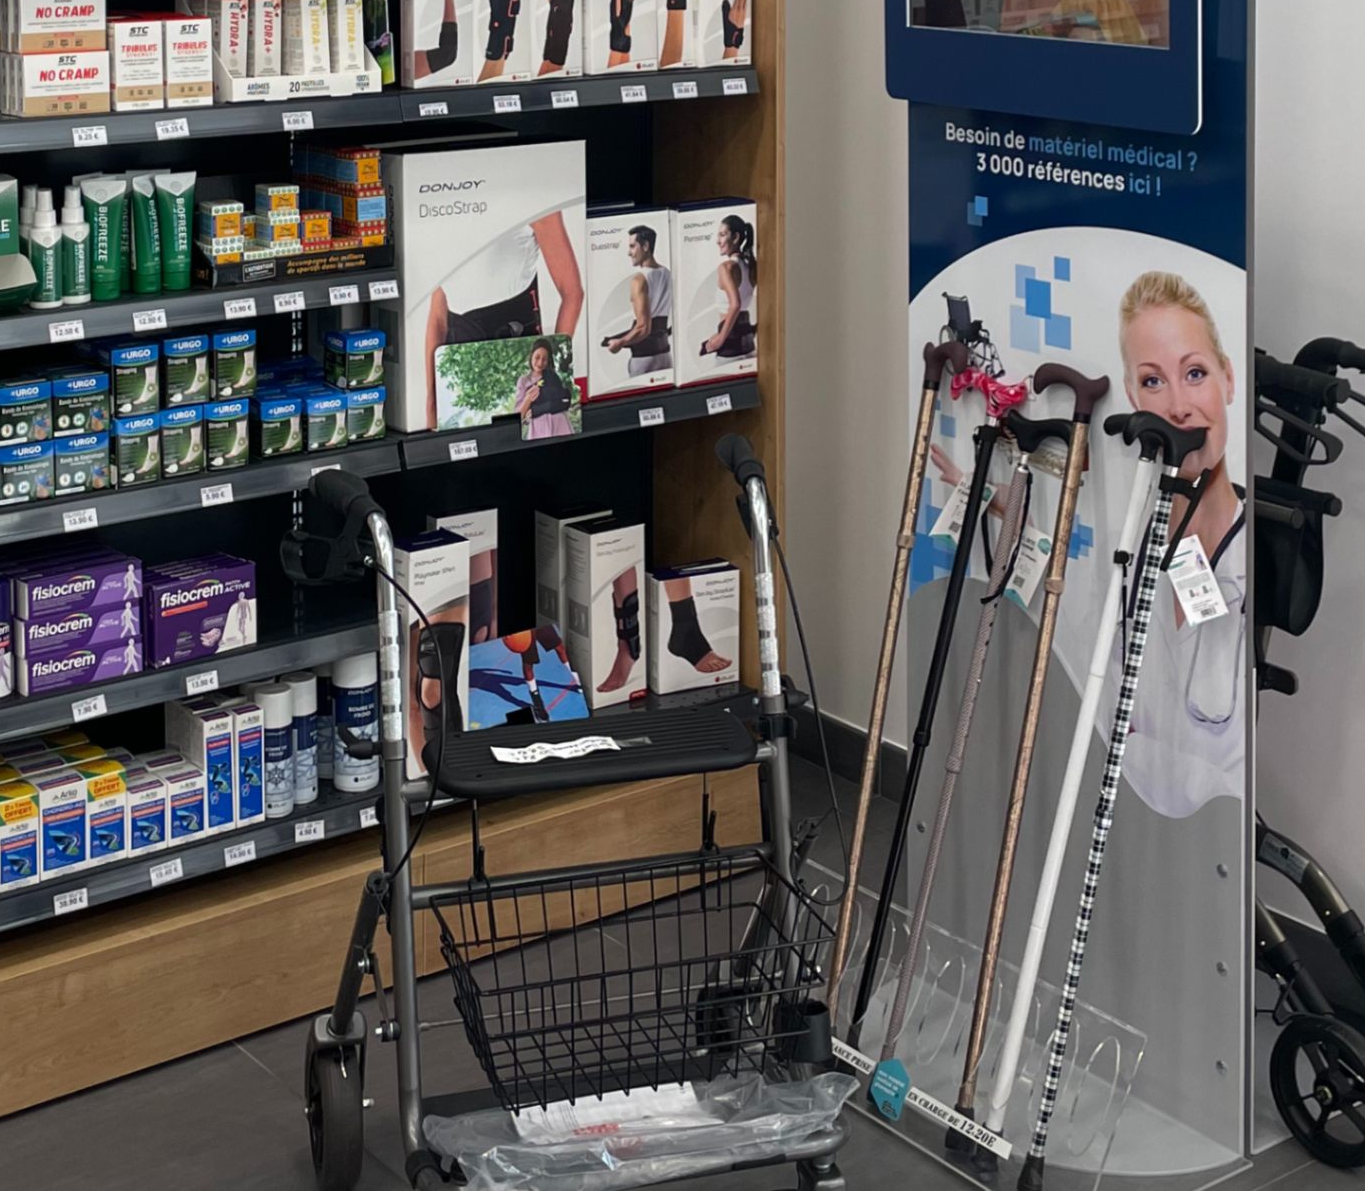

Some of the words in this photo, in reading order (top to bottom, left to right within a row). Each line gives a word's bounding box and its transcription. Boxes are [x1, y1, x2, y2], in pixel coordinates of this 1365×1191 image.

[36, 6, 52, 18] NO
[55, 5, 94, 18] CRAMP
[290, 82, 300, 92] 20
[945, 122, 1001, 150] Besoin
[1004, 128, 1025, 151] de
[1029, 132, 1103, 161] matériel
[1107, 140, 1182, 170] médical
[1187, 151, 1198, 171] ?
[1027, 159, 1125, 192] références
[1129, 173, 1151, 195] ici
[1155, 177, 1161, 195] !
[419, 180, 483, 193] DONJOY
[419, 201, 487, 219] DiscoStrap
[178, 340, 201, 349] URGO
[228, 334, 249, 343] URGO
[126, 349, 150, 358] URGO
[33, 579, 95, 601] fisiocrem
[29, 616, 92, 639] fisiocrem
[833, 1044, 850, 1060] ANCE
[852, 1056, 873, 1072] PRISE
[908, 1091, 918, 1101] EN
[919, 1097, 947, 1120] CHARGE
[947, 1114, 960, 1126] DE
